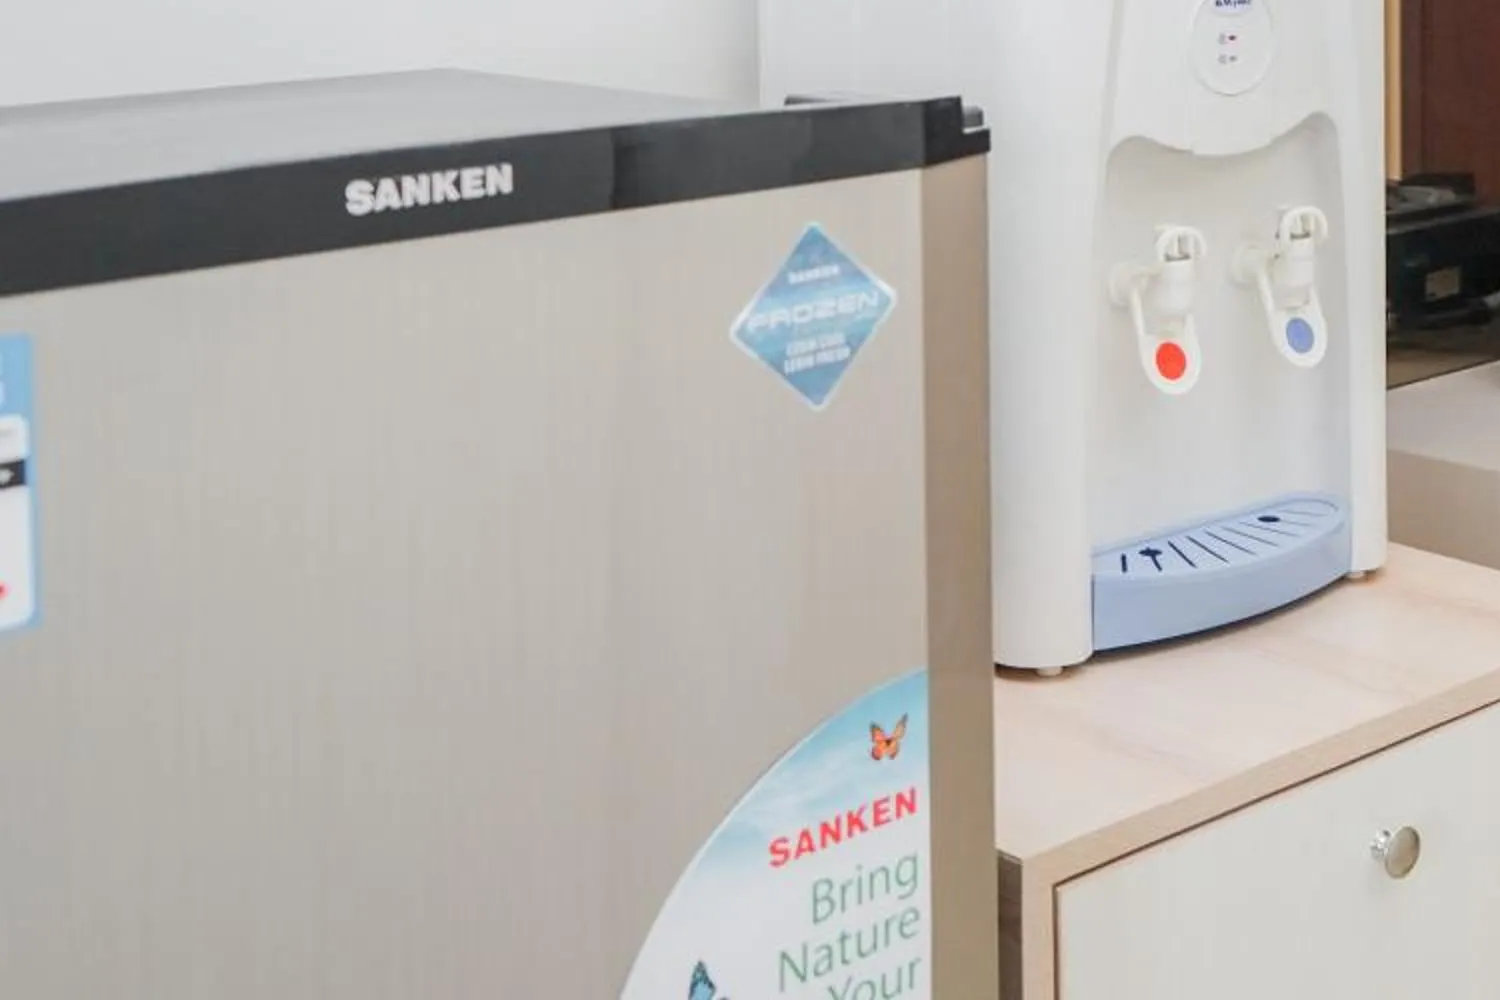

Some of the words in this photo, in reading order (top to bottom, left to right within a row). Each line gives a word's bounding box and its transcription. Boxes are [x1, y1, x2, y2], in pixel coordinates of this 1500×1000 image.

[345, 162, 513, 216] SANKEN
[747, 290, 879, 333] FROZEN
[769, 786, 917, 868] SANKEN
[812, 851, 918, 925] Bring
[779, 907, 921, 993] Nature
